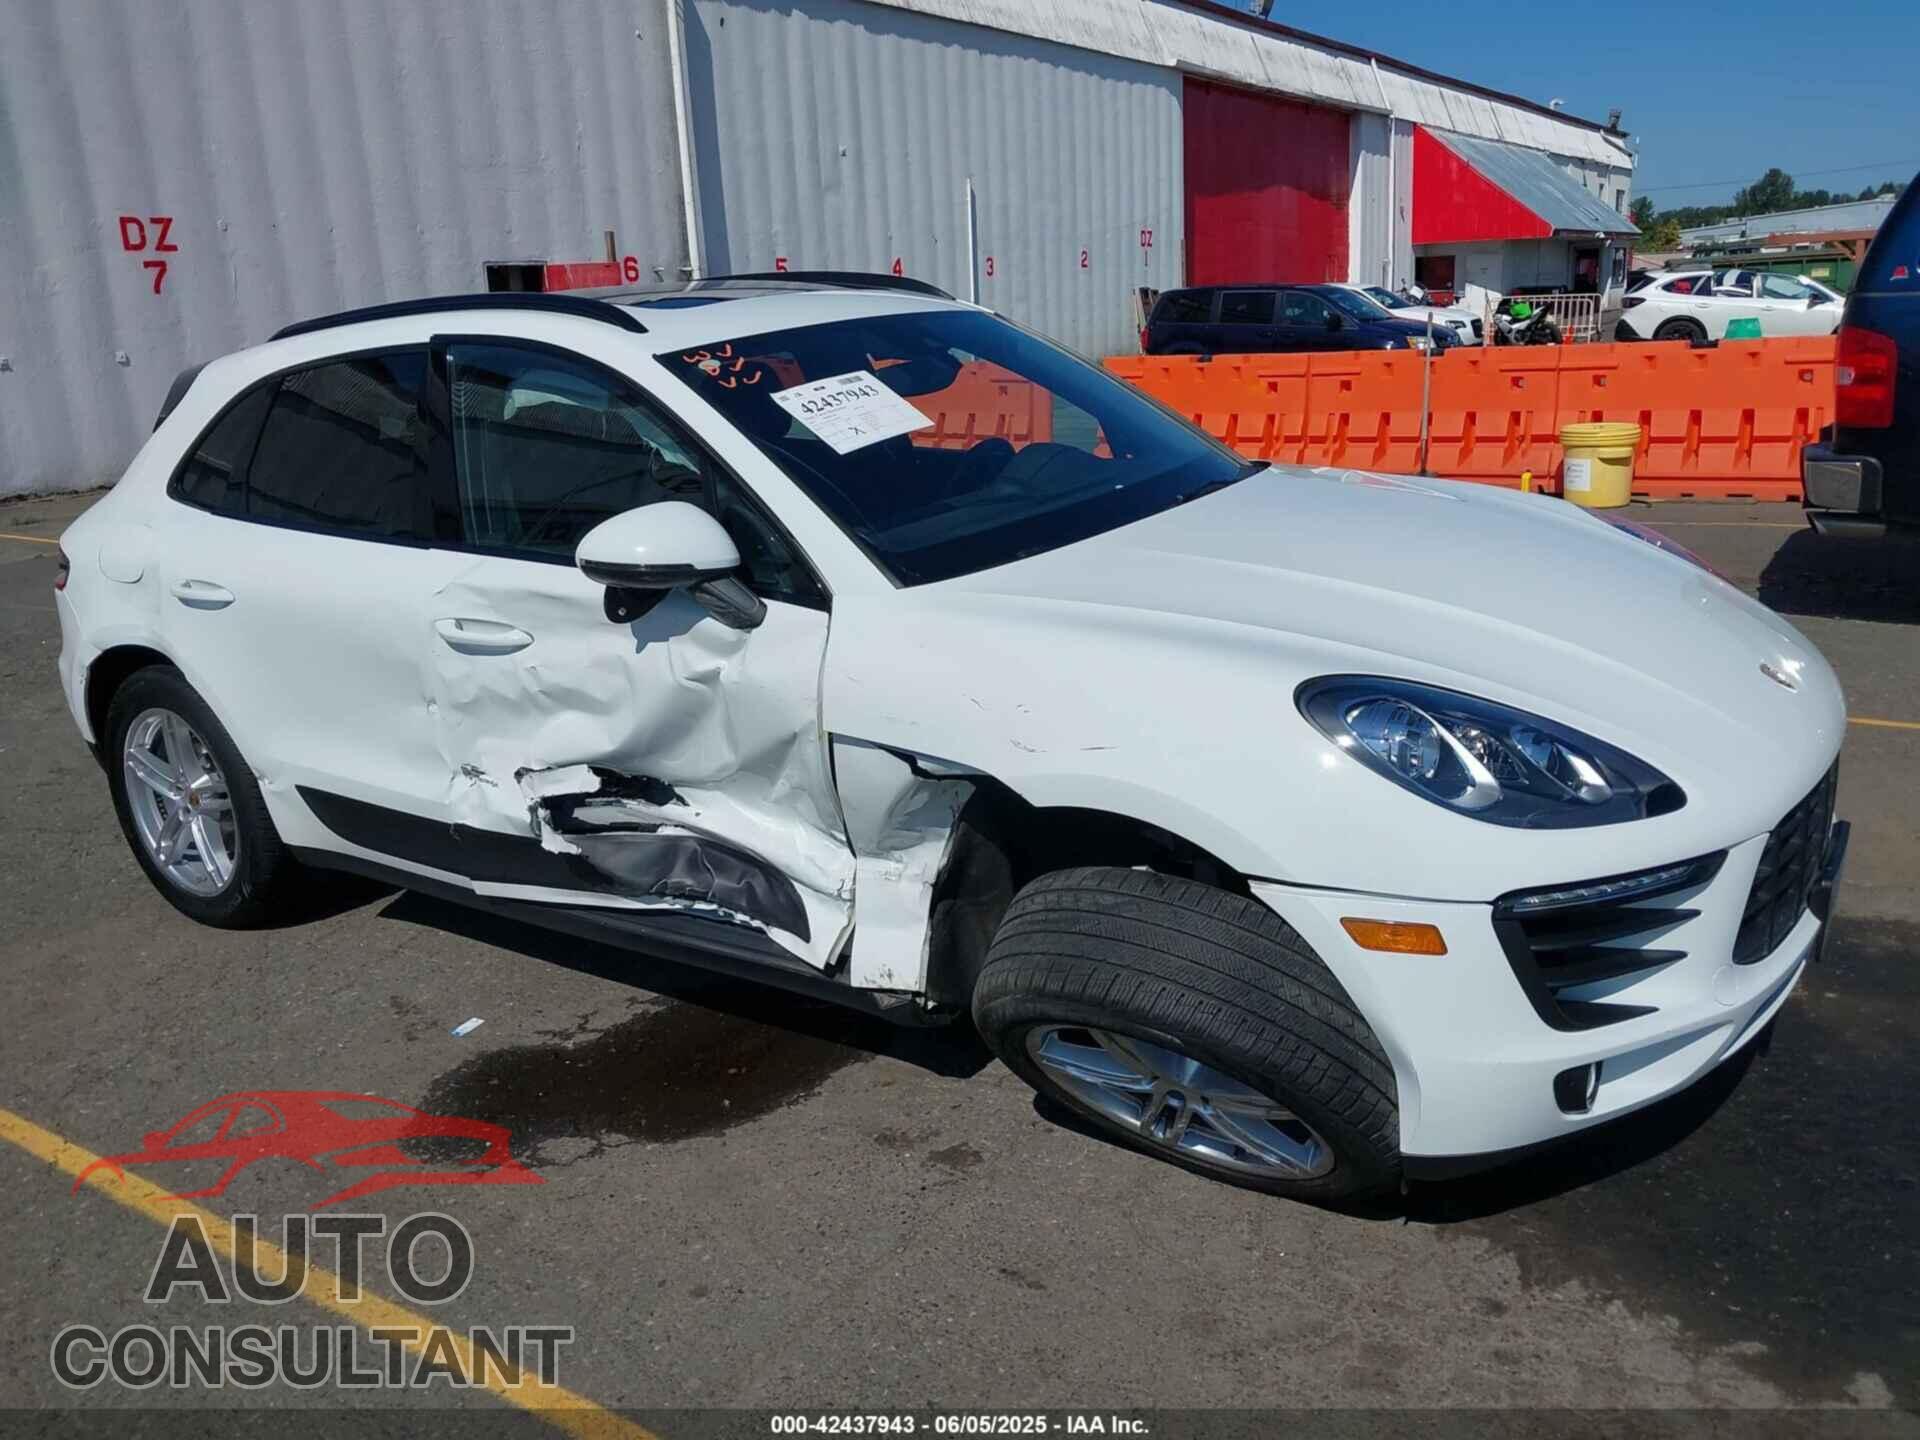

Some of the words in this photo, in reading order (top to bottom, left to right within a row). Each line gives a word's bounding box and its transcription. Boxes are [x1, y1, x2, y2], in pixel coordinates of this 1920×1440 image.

[119, 216, 178, 251] DZ
[1140, 229, 1153, 247] DZ
[623, 256, 639, 282] 6
[892, 257, 904, 276] 4
[986, 257, 994, 277] 3
[1080, 250, 1089, 268] 2
[143, 260, 167, 295] 7
[801, 384, 879, 414] 42437943
